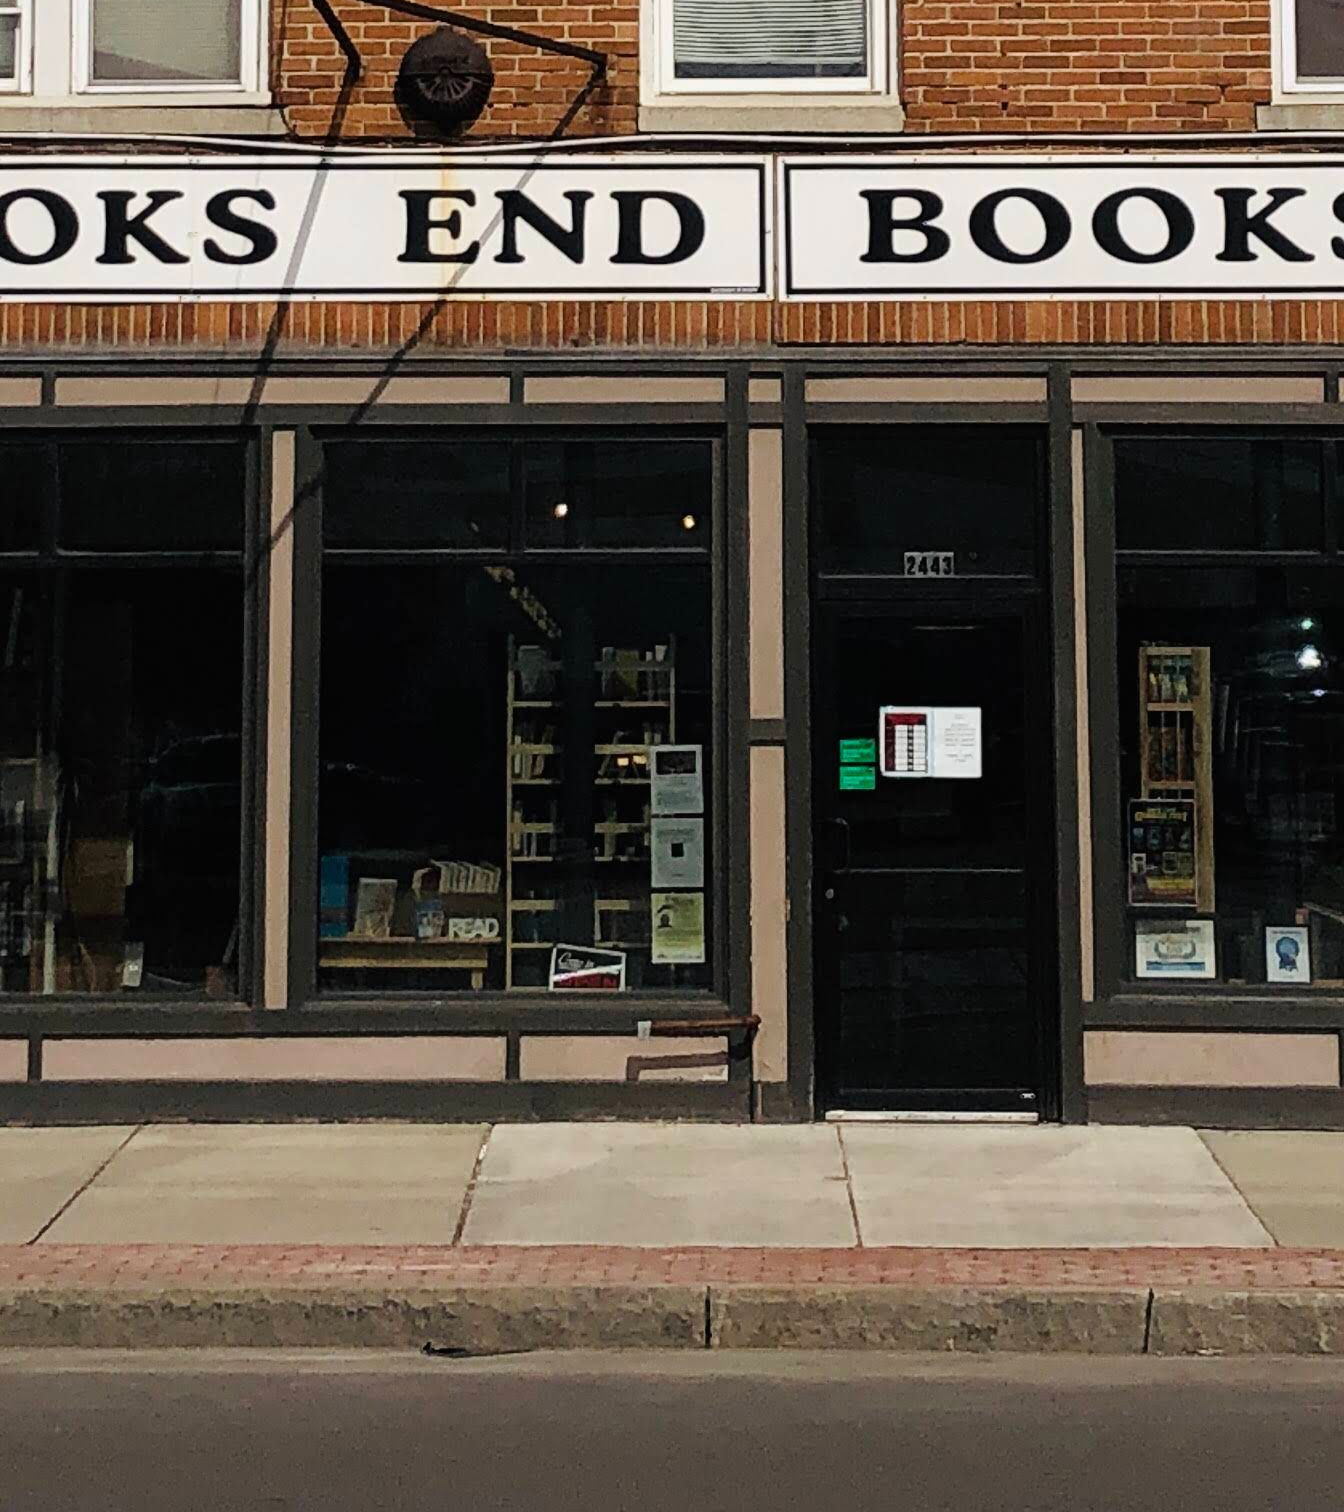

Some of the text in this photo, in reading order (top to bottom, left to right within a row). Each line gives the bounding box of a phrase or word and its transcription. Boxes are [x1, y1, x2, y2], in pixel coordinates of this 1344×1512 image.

[398, 190, 704, 264] END
[906, 556, 953, 575] 2443
[449, 917, 500, 939] READ
